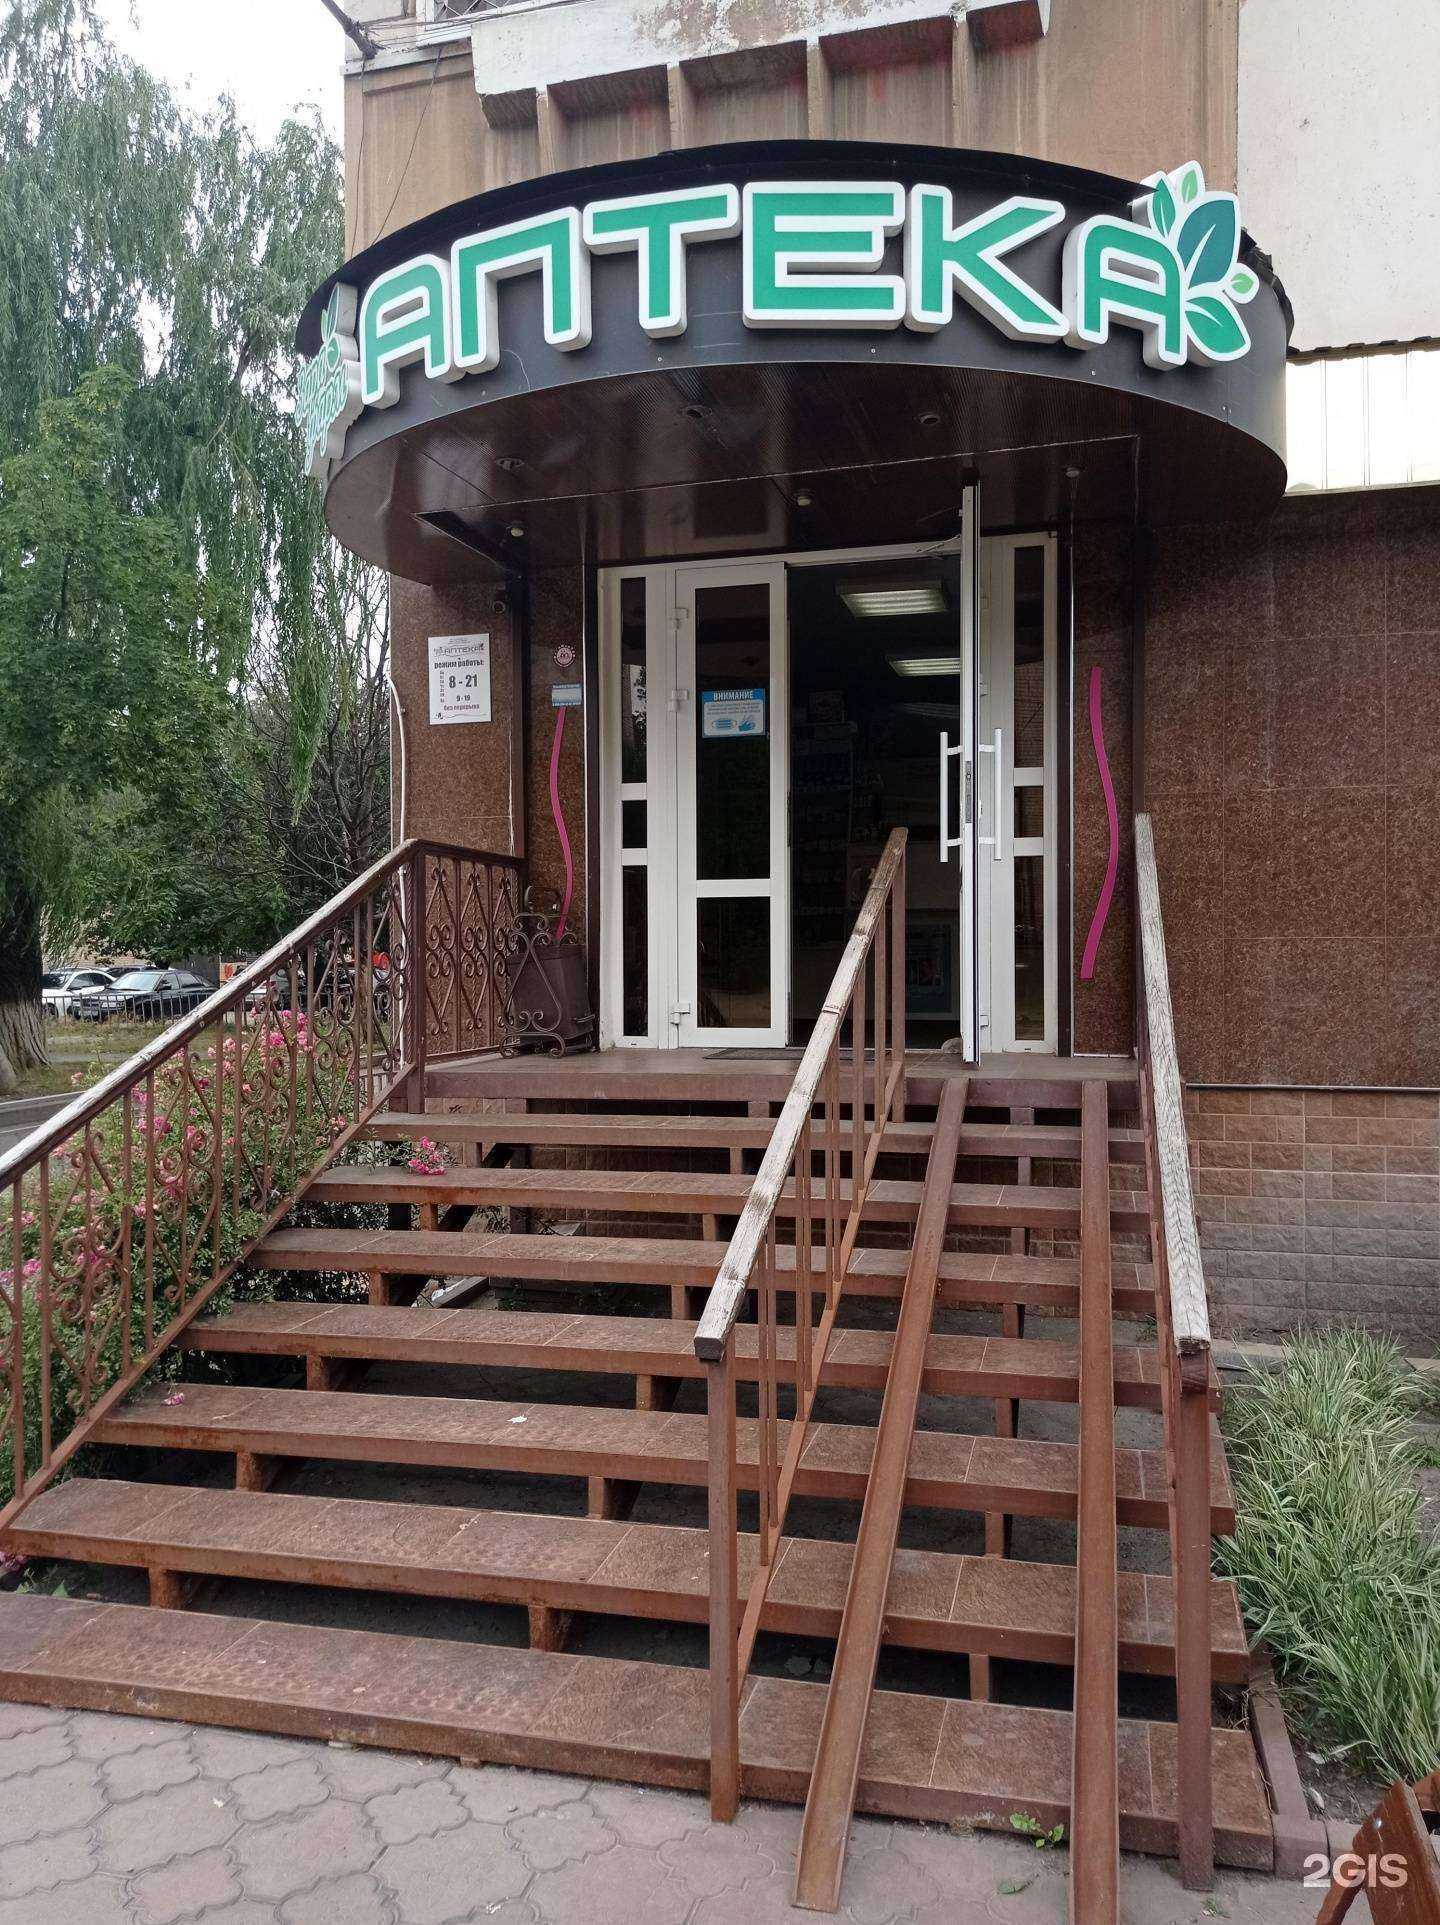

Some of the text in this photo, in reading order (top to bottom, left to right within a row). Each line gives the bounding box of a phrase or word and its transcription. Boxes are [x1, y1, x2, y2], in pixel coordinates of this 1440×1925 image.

[360, 180, 1188, 409] АПТЕКА
[449, 675, 457, 688] 8
[465, 674, 478, 687] 21
[713, 690, 754, 701] ВНИМАНИЕ
